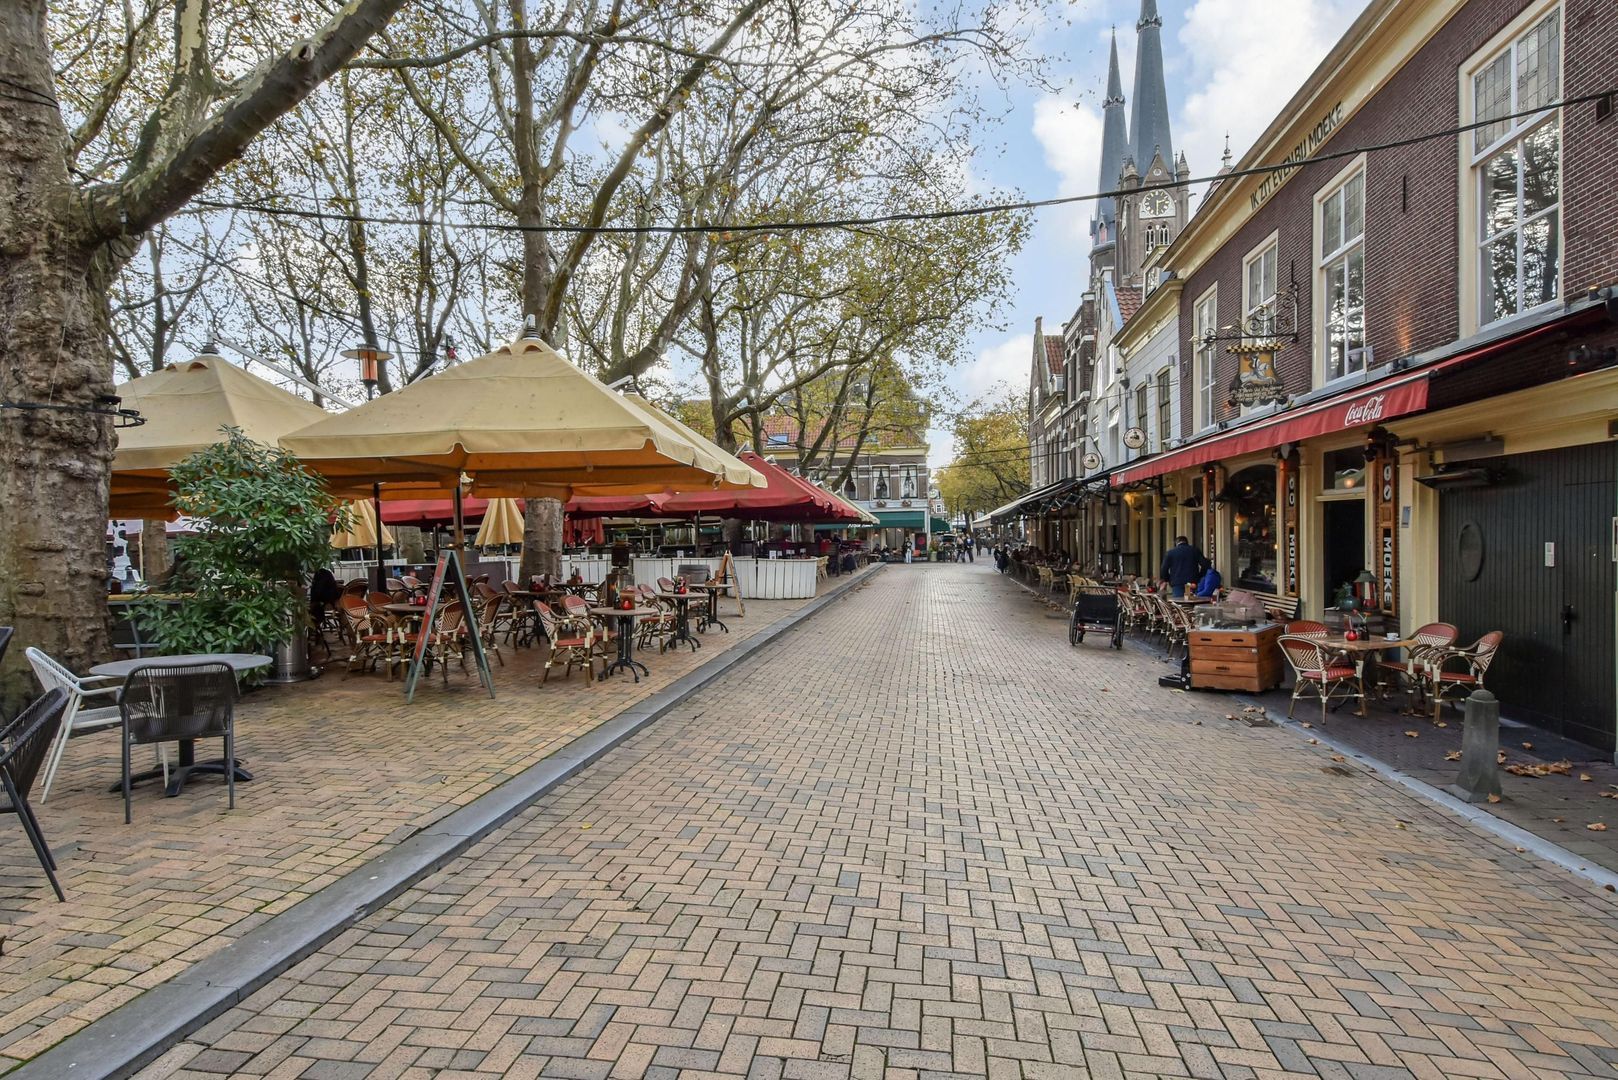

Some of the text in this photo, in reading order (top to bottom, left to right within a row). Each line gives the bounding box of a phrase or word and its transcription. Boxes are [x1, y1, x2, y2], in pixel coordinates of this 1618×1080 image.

[1250, 101, 1343, 210] IK ZIT EVEN BIJ MOEKE
[1383, 537, 1393, 605] MOEKE
